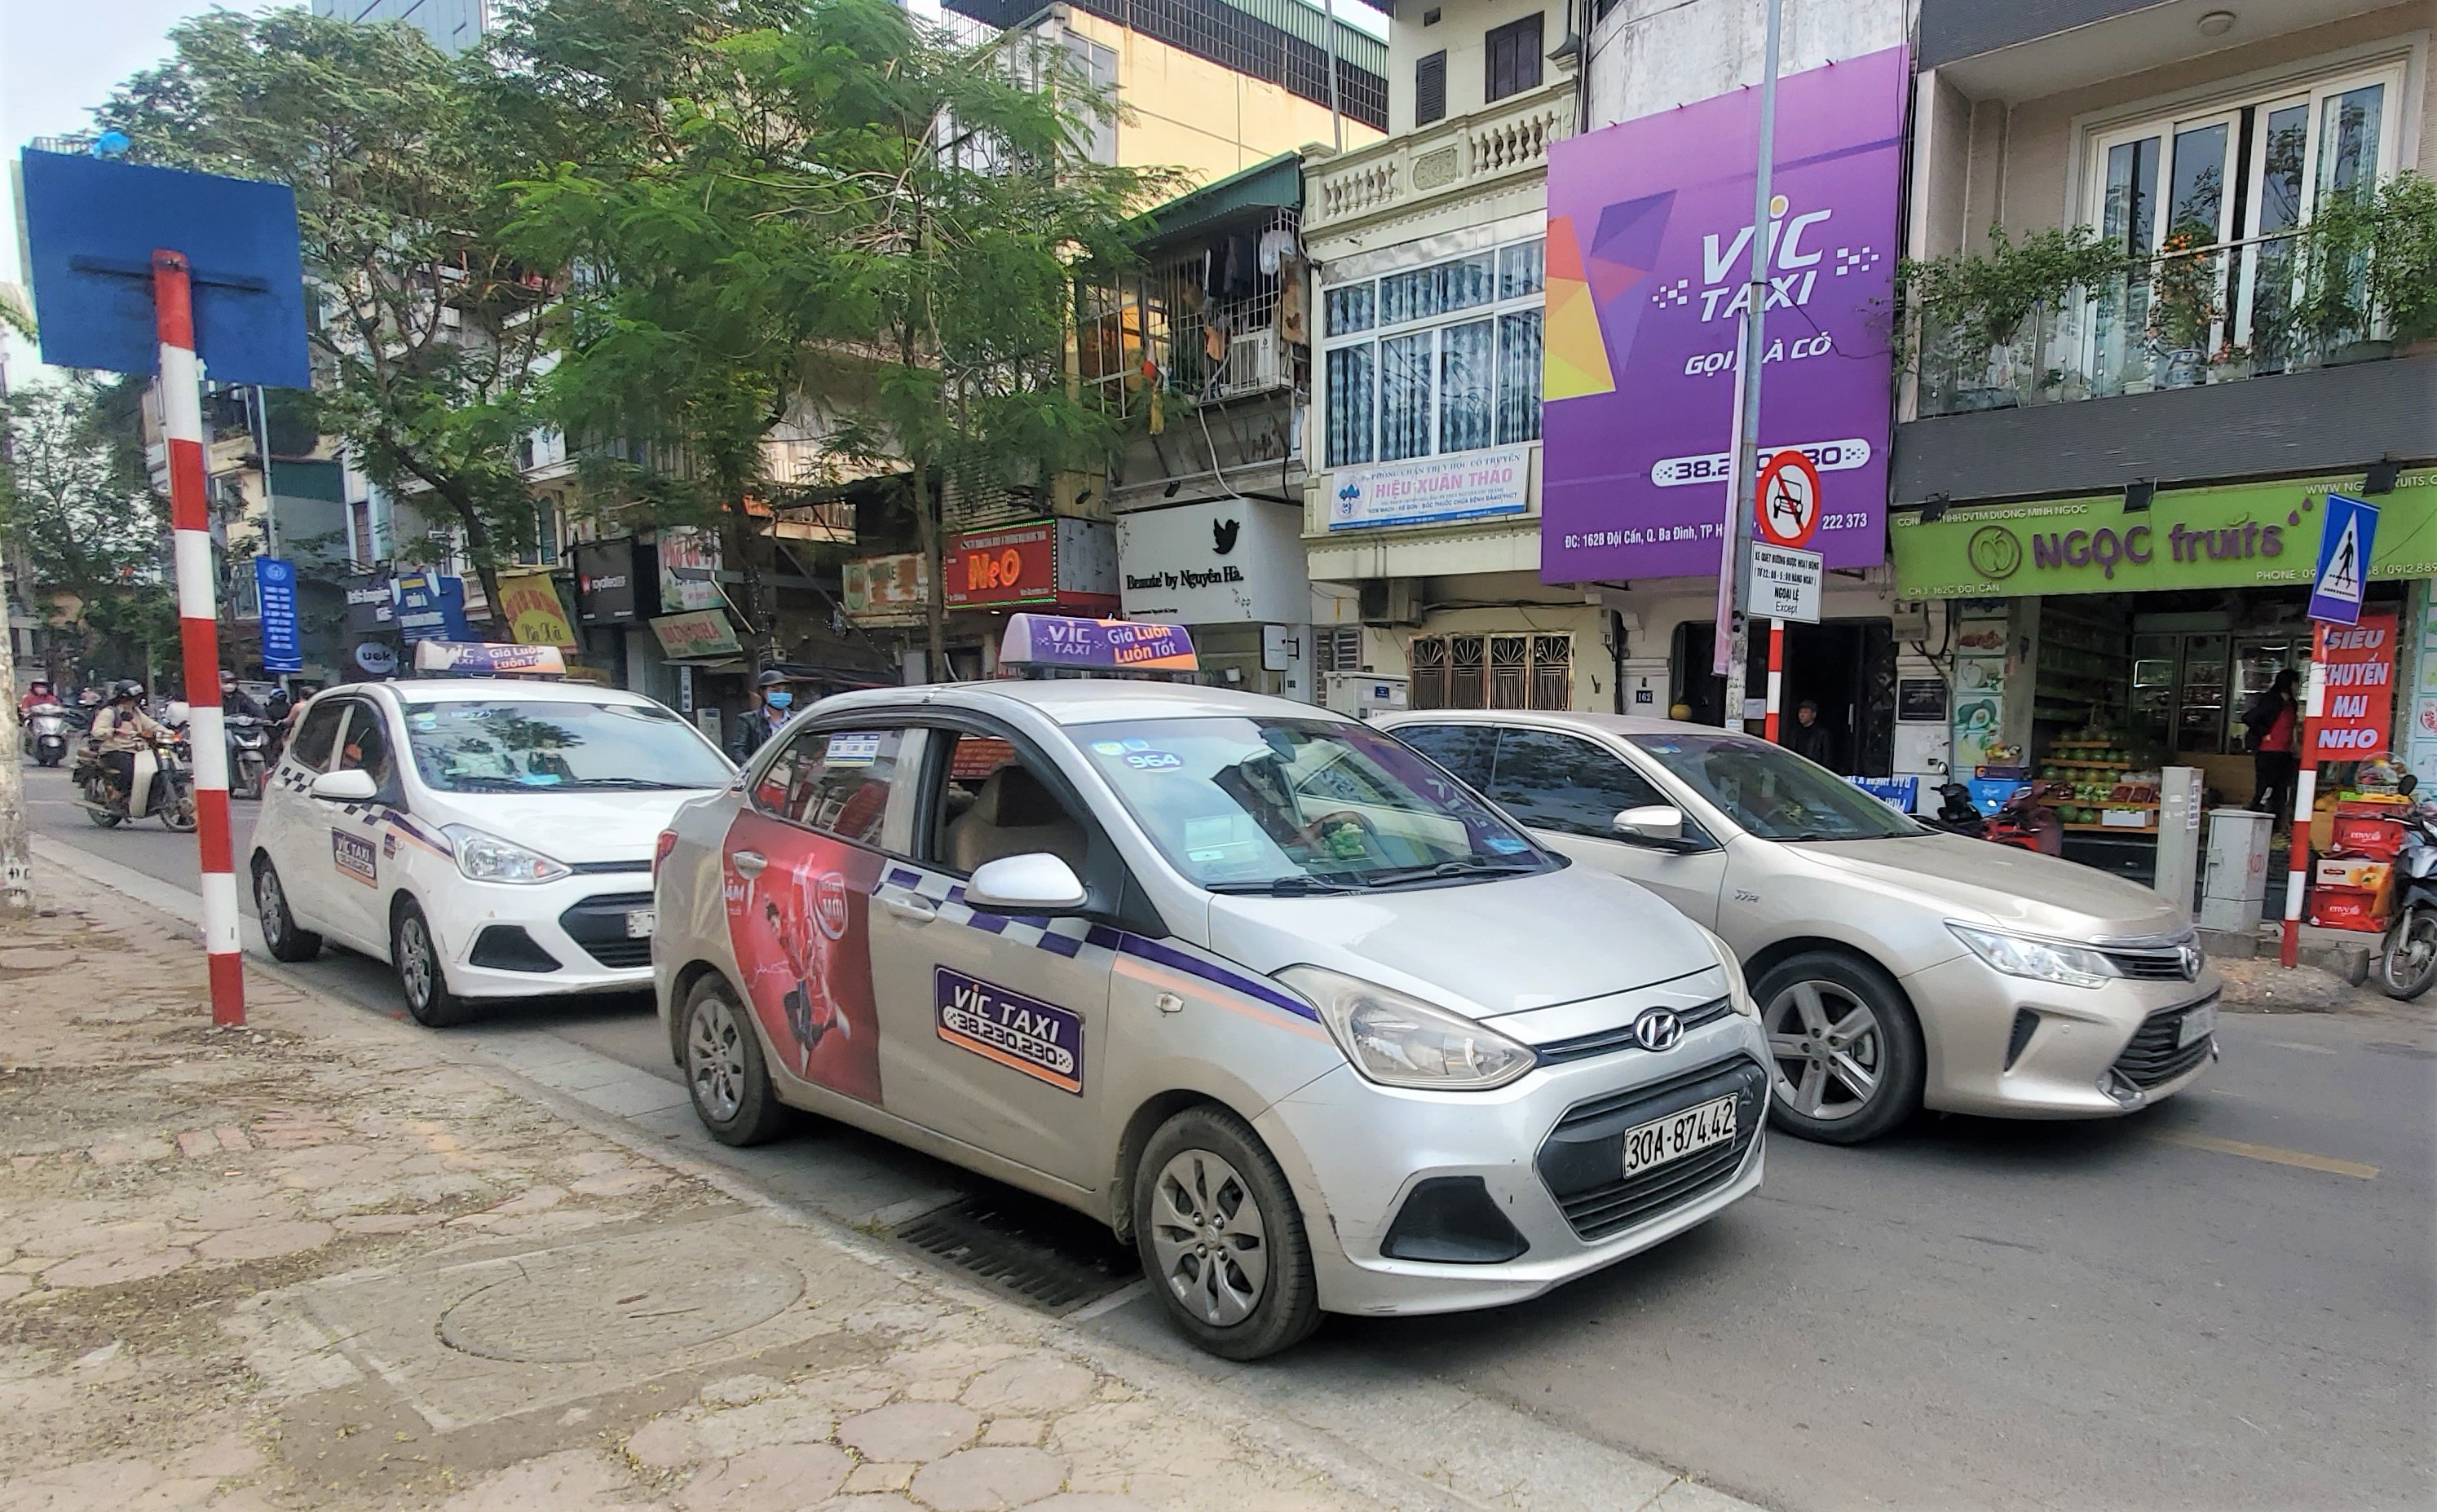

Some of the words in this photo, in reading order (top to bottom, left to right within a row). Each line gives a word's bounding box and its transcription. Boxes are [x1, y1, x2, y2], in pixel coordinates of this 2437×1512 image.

[1700, 270, 1817, 322] TAXI
[1684, 350, 1734, 377] GỌI
[1790, 331, 1832, 359] CÓ
[1375, 478, 1411, 500] HIỆU
[1416, 472, 1463, 493] XUÂN
[1468, 465, 1513, 487] THẢO
[1565, 535, 1581, 549] ĐC:
[1583, 534, 1605, 547] 162B
[1646, 529, 1656, 543] Q.
[1658, 528, 1671, 541] Ba
[1673, 525, 1698, 541] Đình,
[1700, 524, 1712, 539] TP
[1822, 514, 1843, 530] 222
[1846, 513, 1867, 529] 373
[2033, 525, 2153, 580] NGỌC
[2169, 519, 2284, 562] fruits
[968, 548, 1021, 590] NeO
[1163, 571, 1178, 590] by
[1774, 586, 1792, 602] NGOẠI
[1775, 601, 1798, 616] Except
[1107, 626, 1134, 644] Giá
[1135, 625, 1172, 641] Luôn
[2328, 626, 2386, 650] SIÊU
[1053, 643, 1091, 655] TAXI
[1114, 645, 1152, 664] Luôn
[1154, 637, 1177, 656] Tốt
[1638, 692, 1652, 703] 162
[2332, 695, 2369, 725] MẠI
[2318, 728, 2379, 749] NHO
[1127, 753, 1181, 769] 964
[1000, 1003, 1060, 1043] TAXI
[956, 1012, 1057, 1065] 38.230.230
[1628, 1100, 1734, 1170] 30A-874.42
